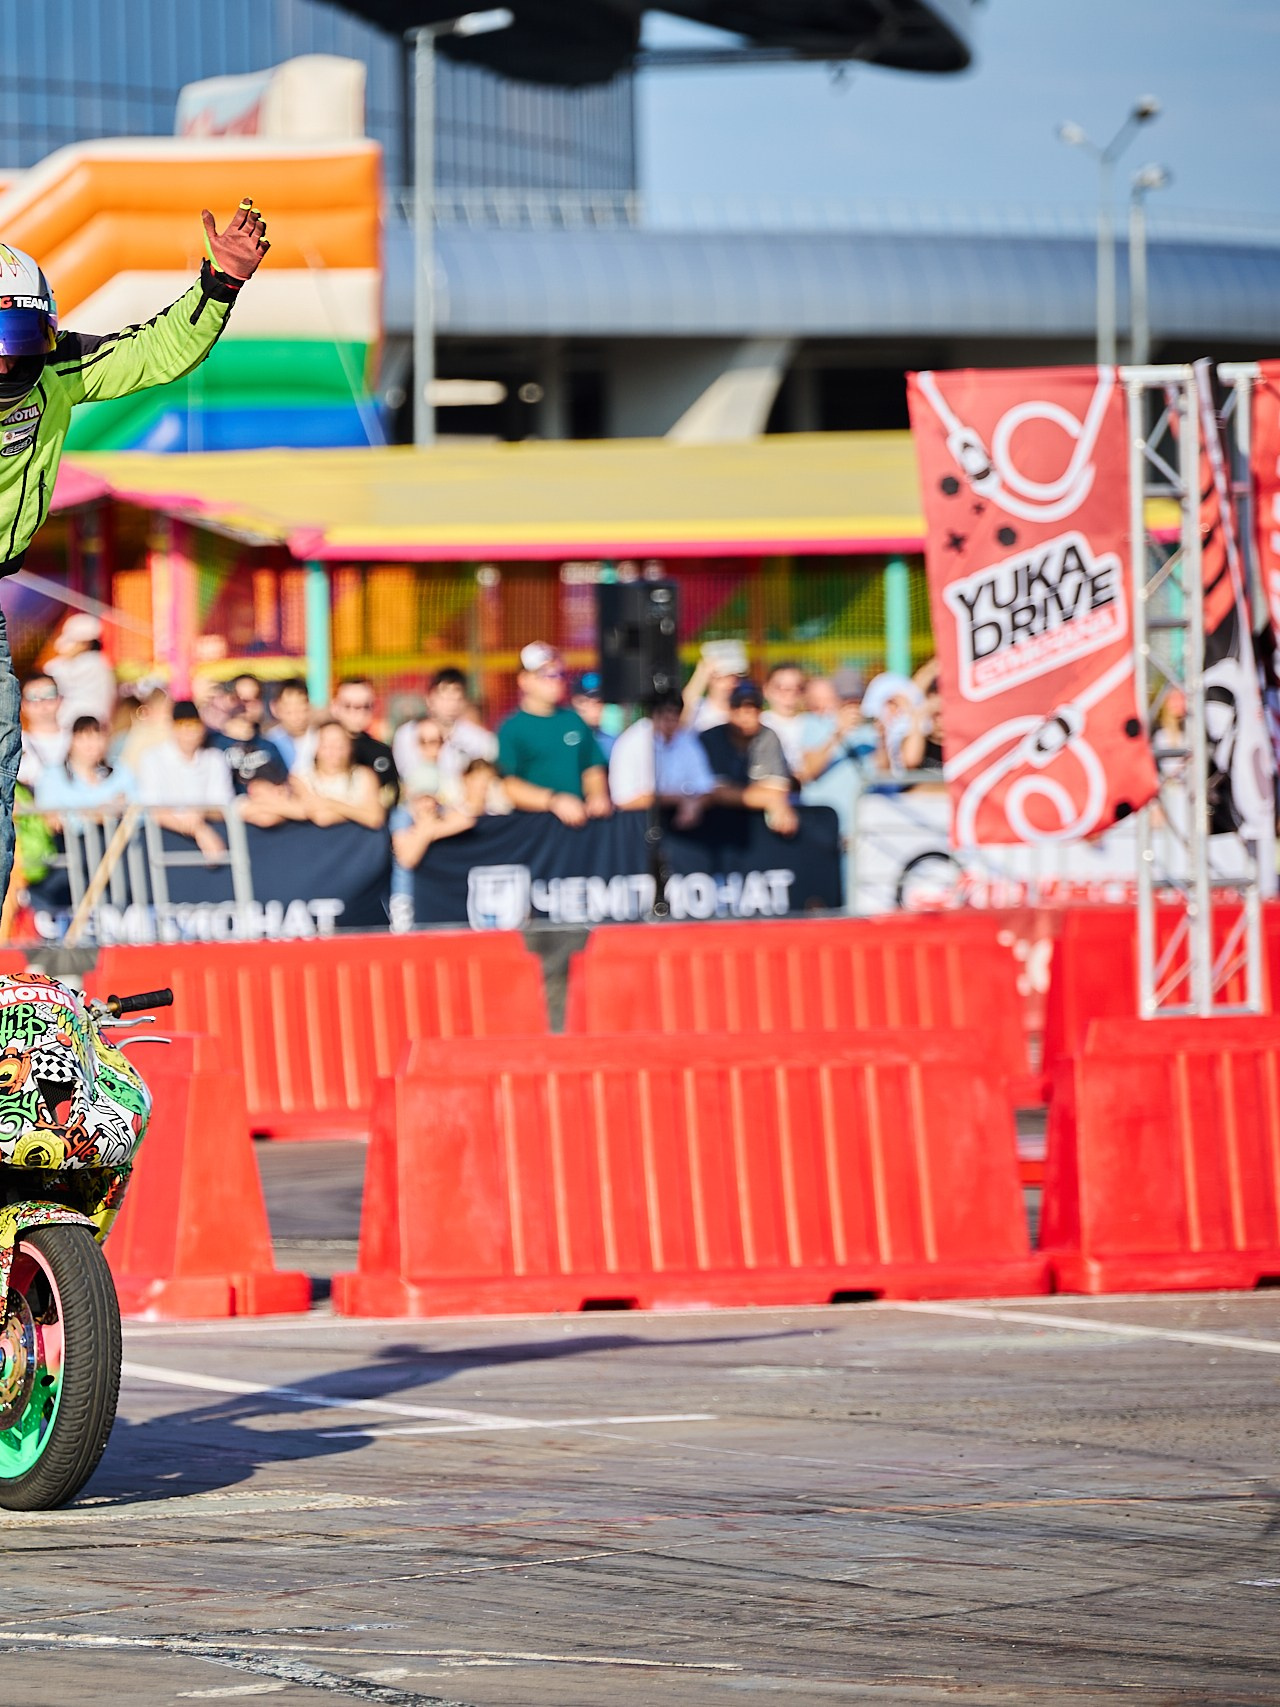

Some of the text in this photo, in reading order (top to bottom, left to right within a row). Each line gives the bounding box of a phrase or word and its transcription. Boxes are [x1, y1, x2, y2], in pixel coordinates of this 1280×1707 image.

[14, 296, 48, 312] TEAM
[3, 405, 39, 424] MOTUL
[958, 546, 1086, 622] YUKA
[972, 569, 1114, 661] DRIVE
